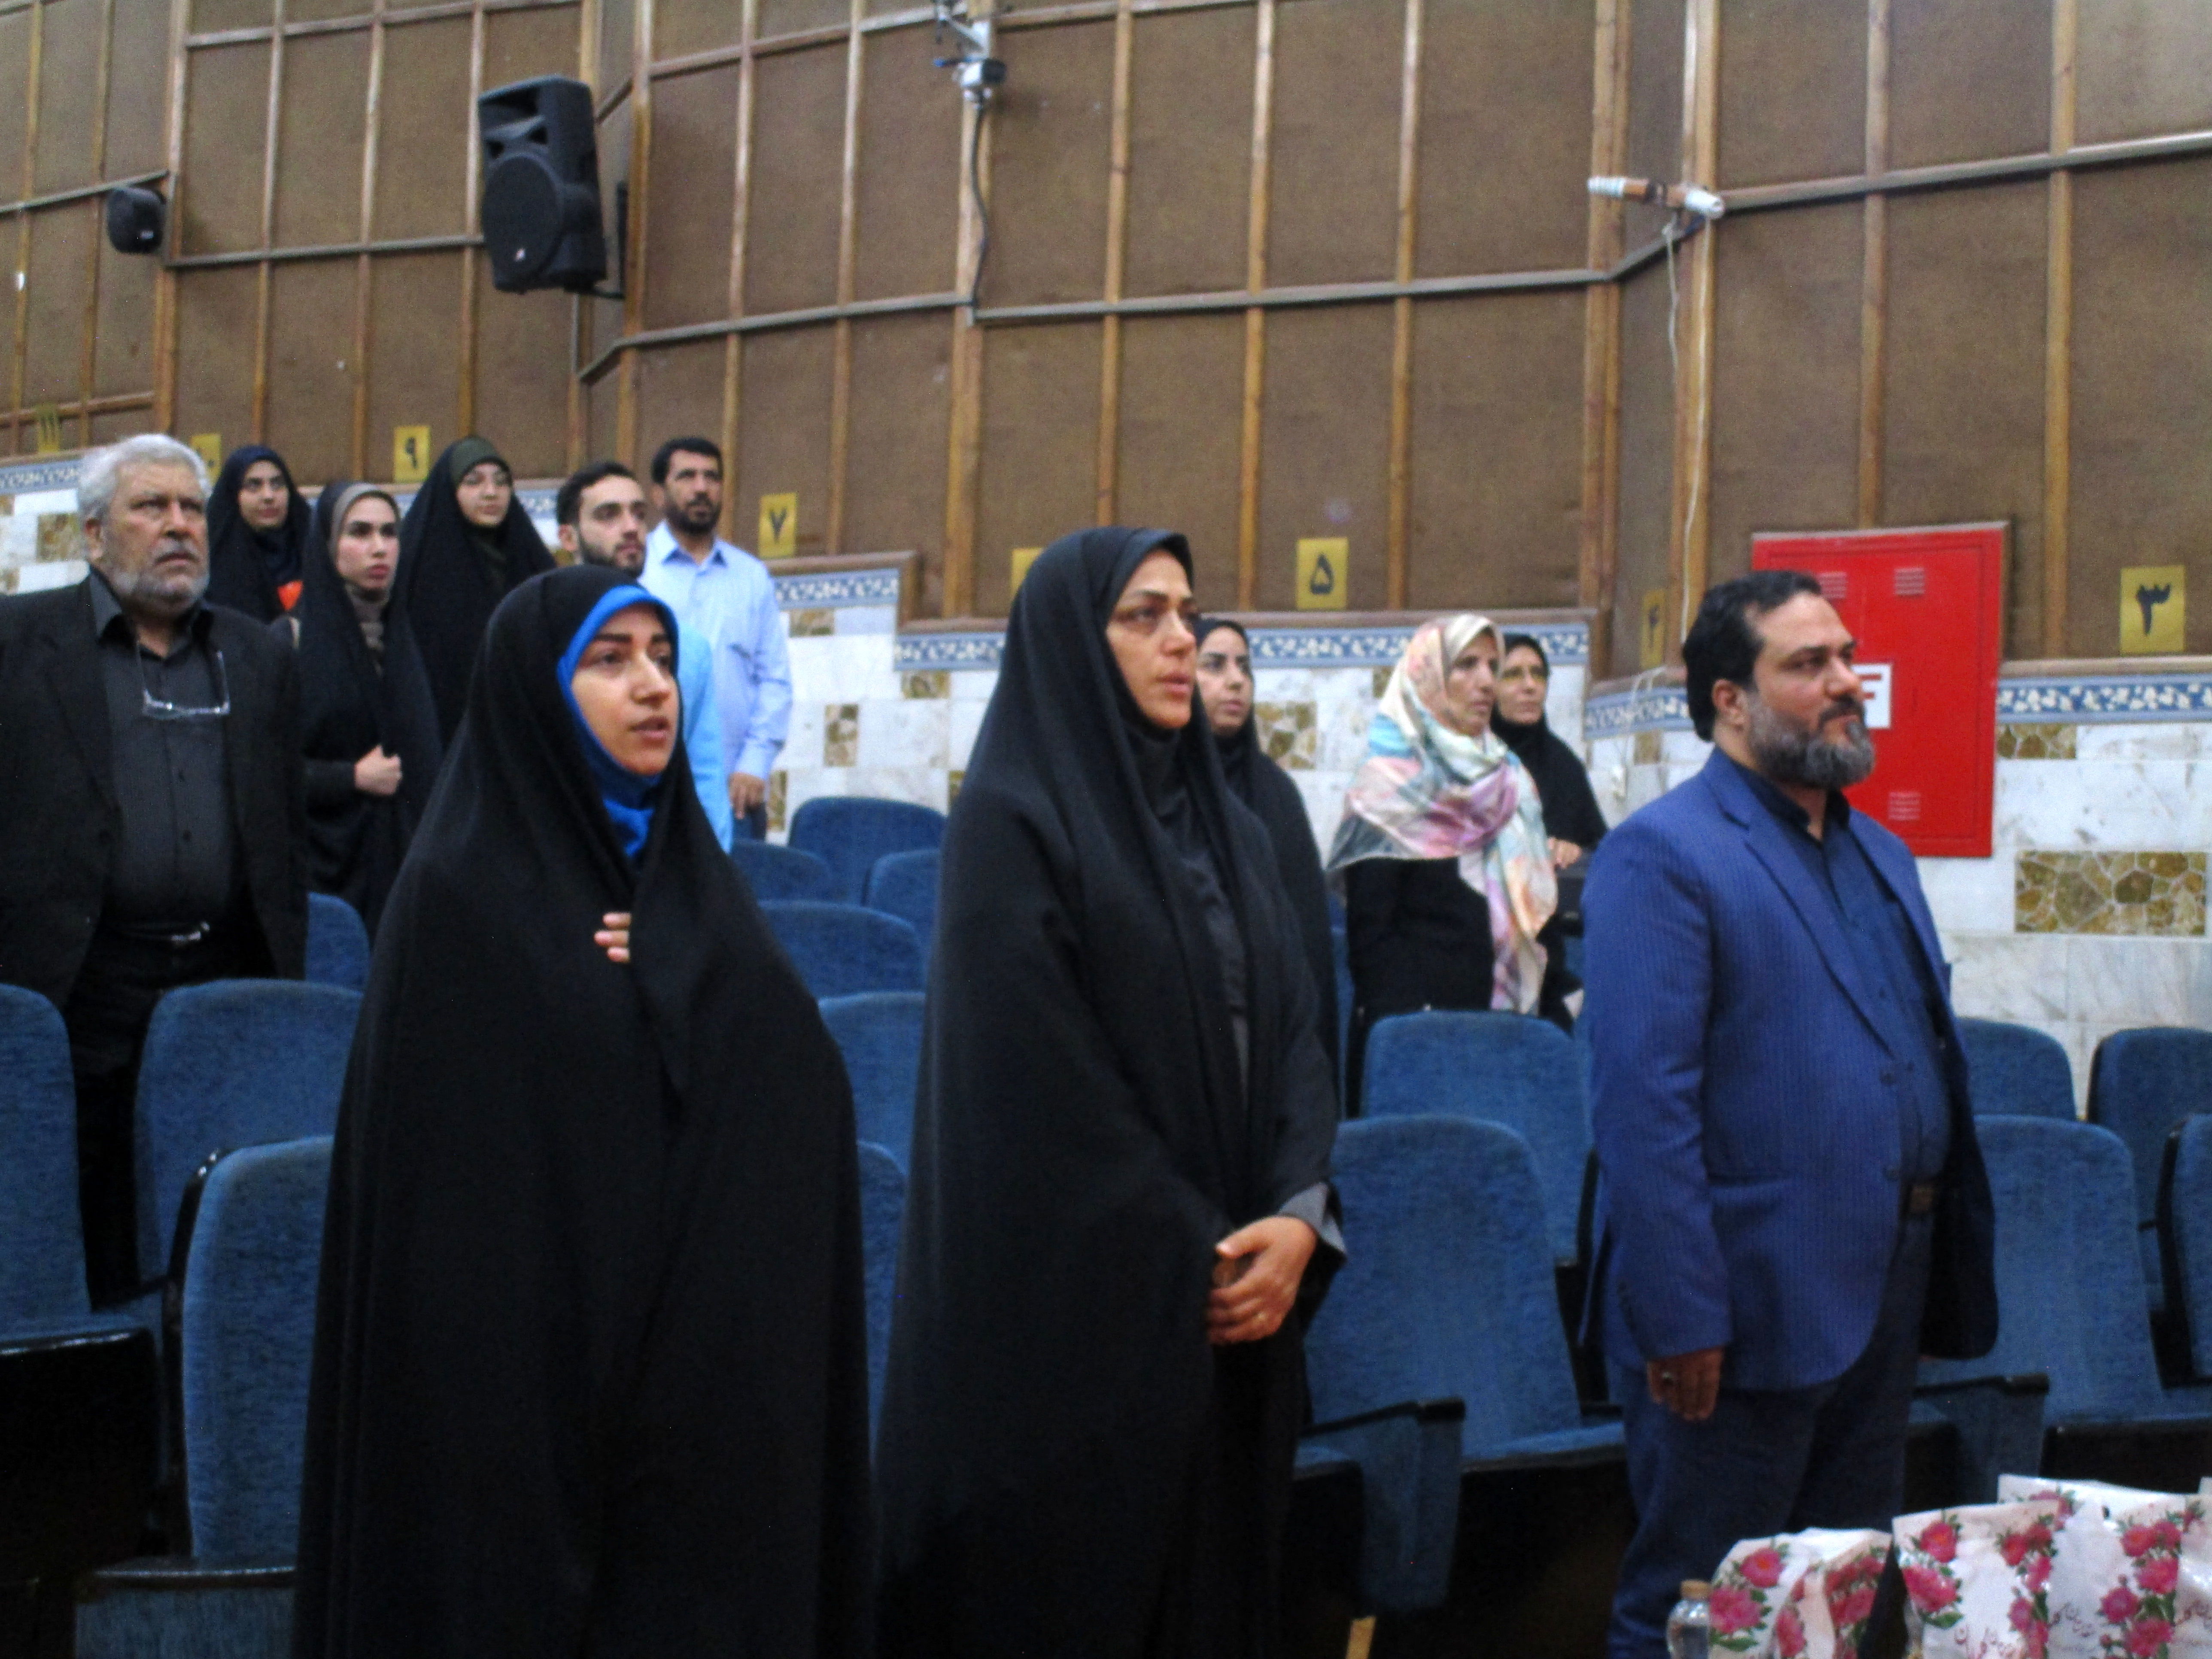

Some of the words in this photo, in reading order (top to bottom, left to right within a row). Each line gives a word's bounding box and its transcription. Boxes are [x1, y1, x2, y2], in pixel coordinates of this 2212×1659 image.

[404, 436, 418, 469] ۹
[769, 506, 787, 544] ۷
[1310, 553, 1334, 596] ۵
[2136, 583, 2172, 635] ۳
